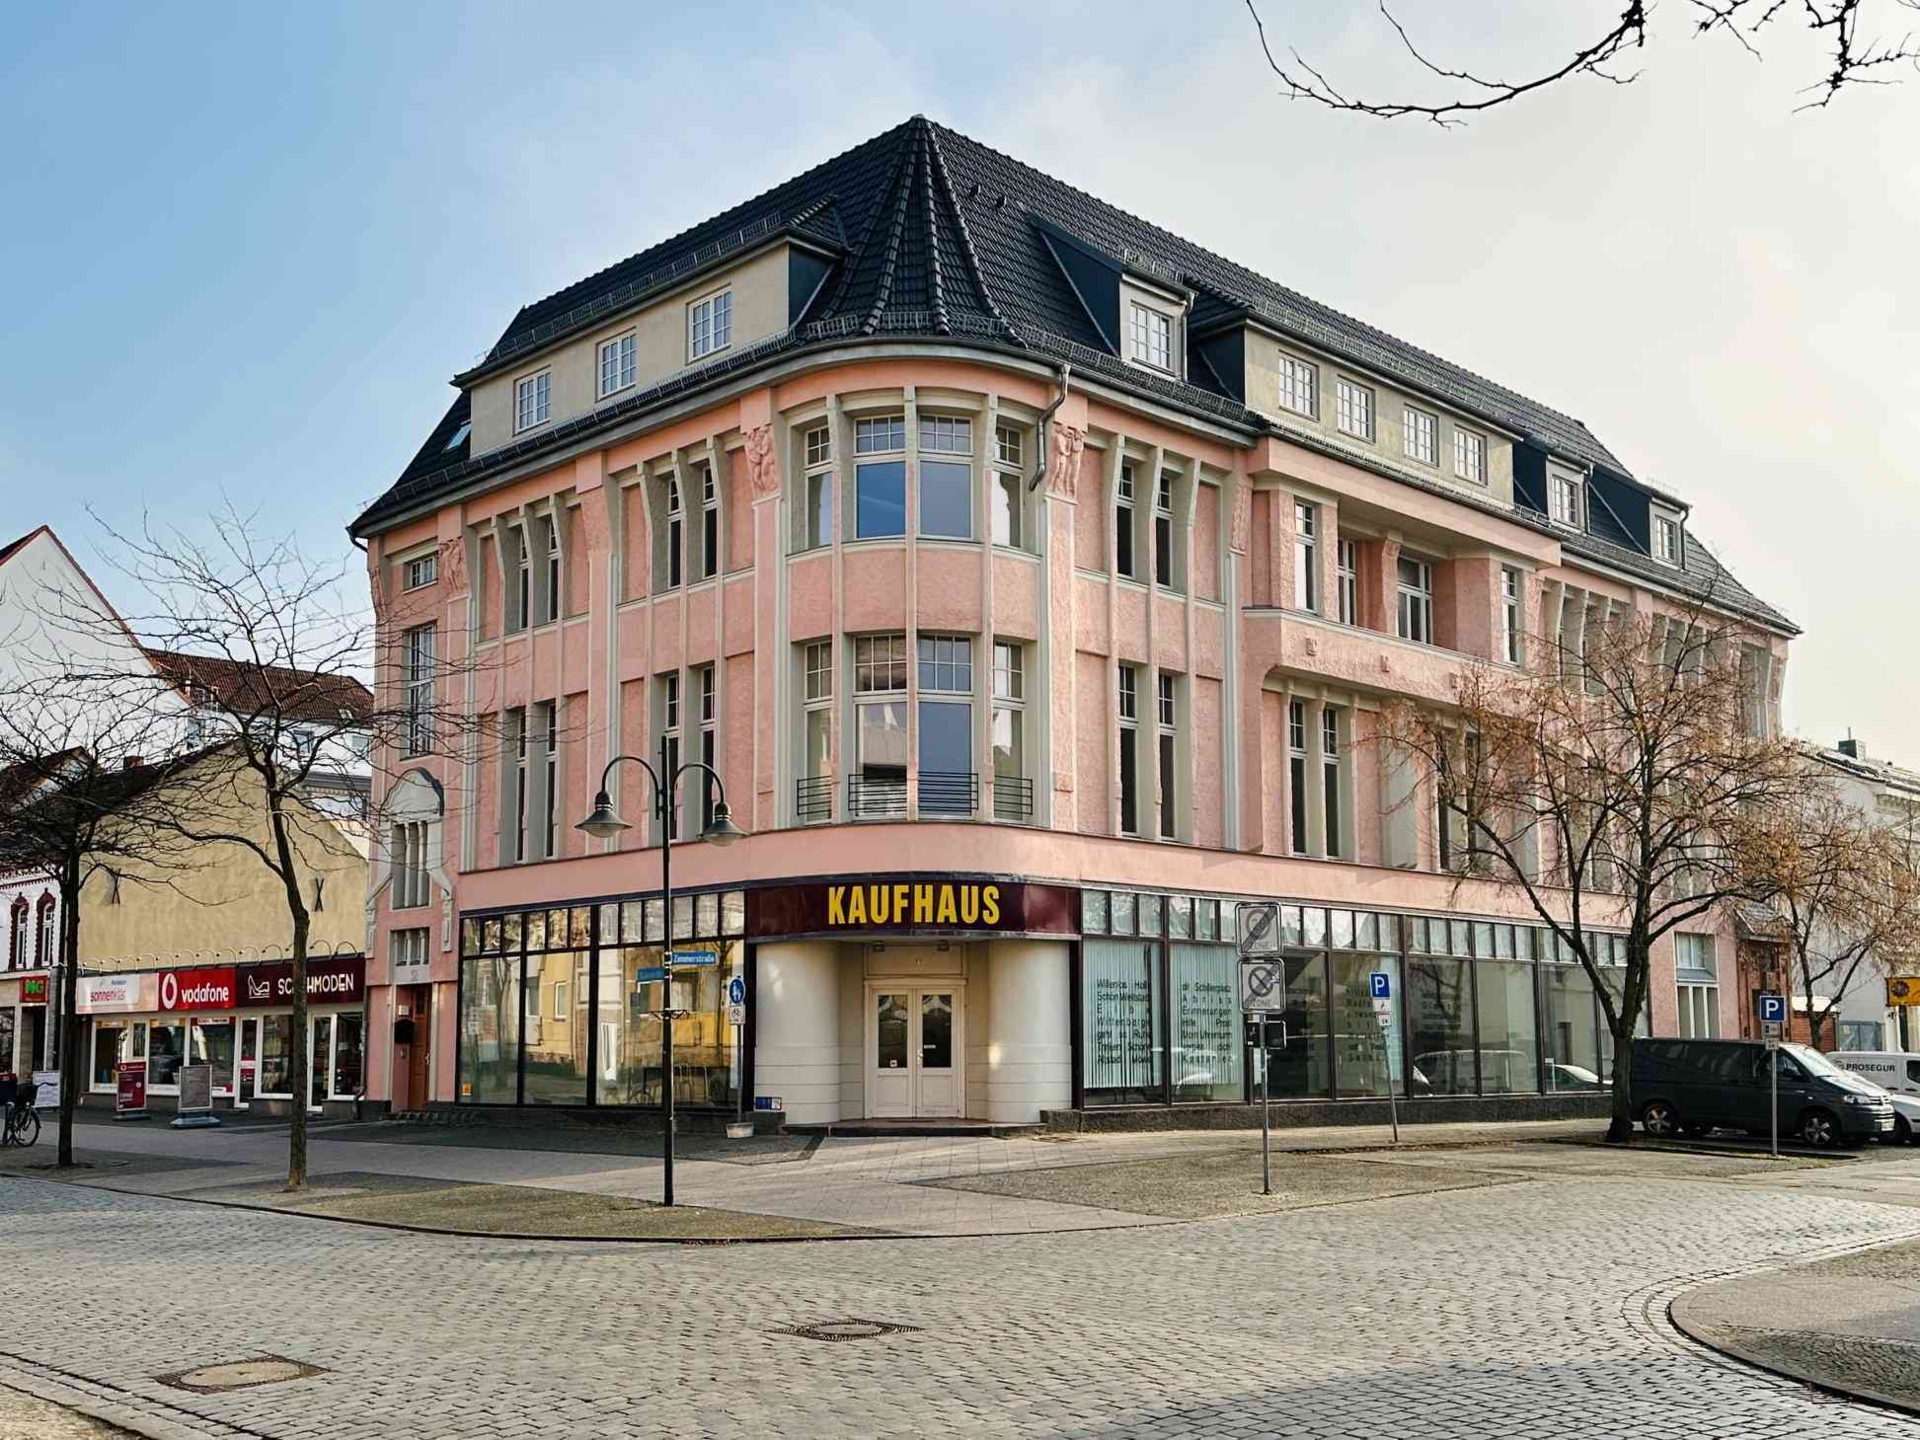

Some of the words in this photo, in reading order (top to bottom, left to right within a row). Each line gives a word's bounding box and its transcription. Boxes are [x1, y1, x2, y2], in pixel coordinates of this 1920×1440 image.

[828, 884, 1000, 925] KAUFHAUS
[181, 983, 229, 1003] vodafone
[1374, 976, 1385, 995] P
[1765, 1000, 1779, 1018] P
[1846, 1063, 1896, 1073] PROSEGUR
